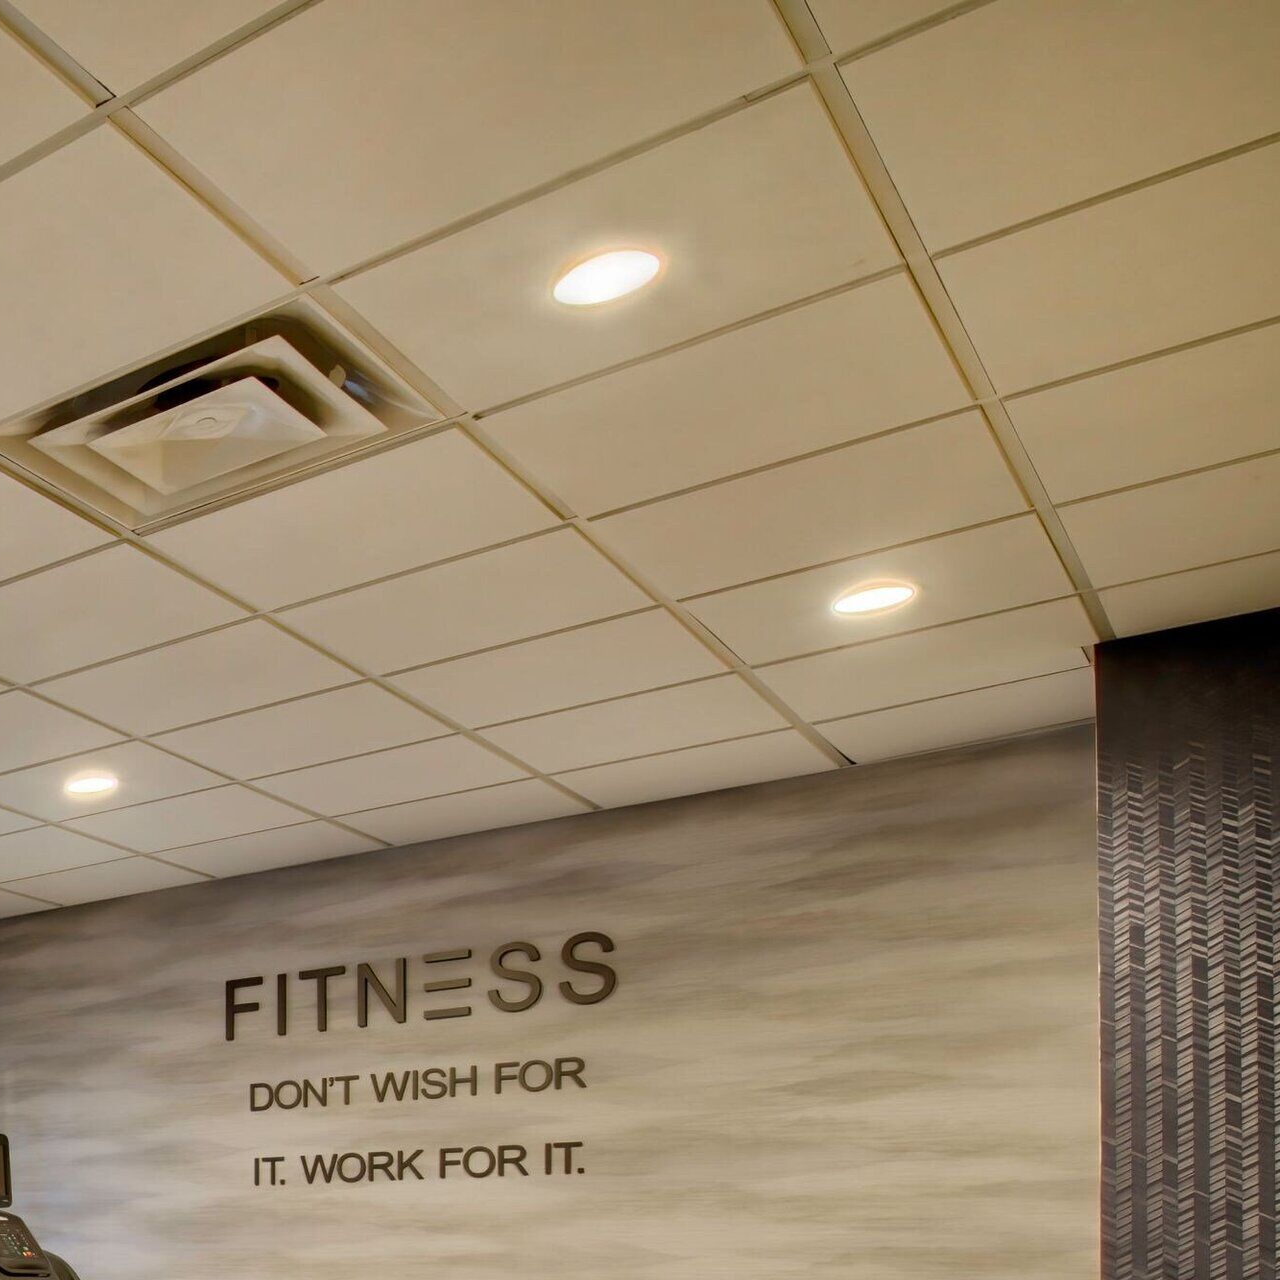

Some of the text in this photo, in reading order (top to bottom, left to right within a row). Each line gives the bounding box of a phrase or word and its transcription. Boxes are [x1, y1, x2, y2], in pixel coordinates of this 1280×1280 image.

[225, 931, 619, 1041] FITNESS
[249, 1056, 588, 1112] DON'T WISH FOR
[254, 1141, 585, 1186] IT. WORK FOR IT.
